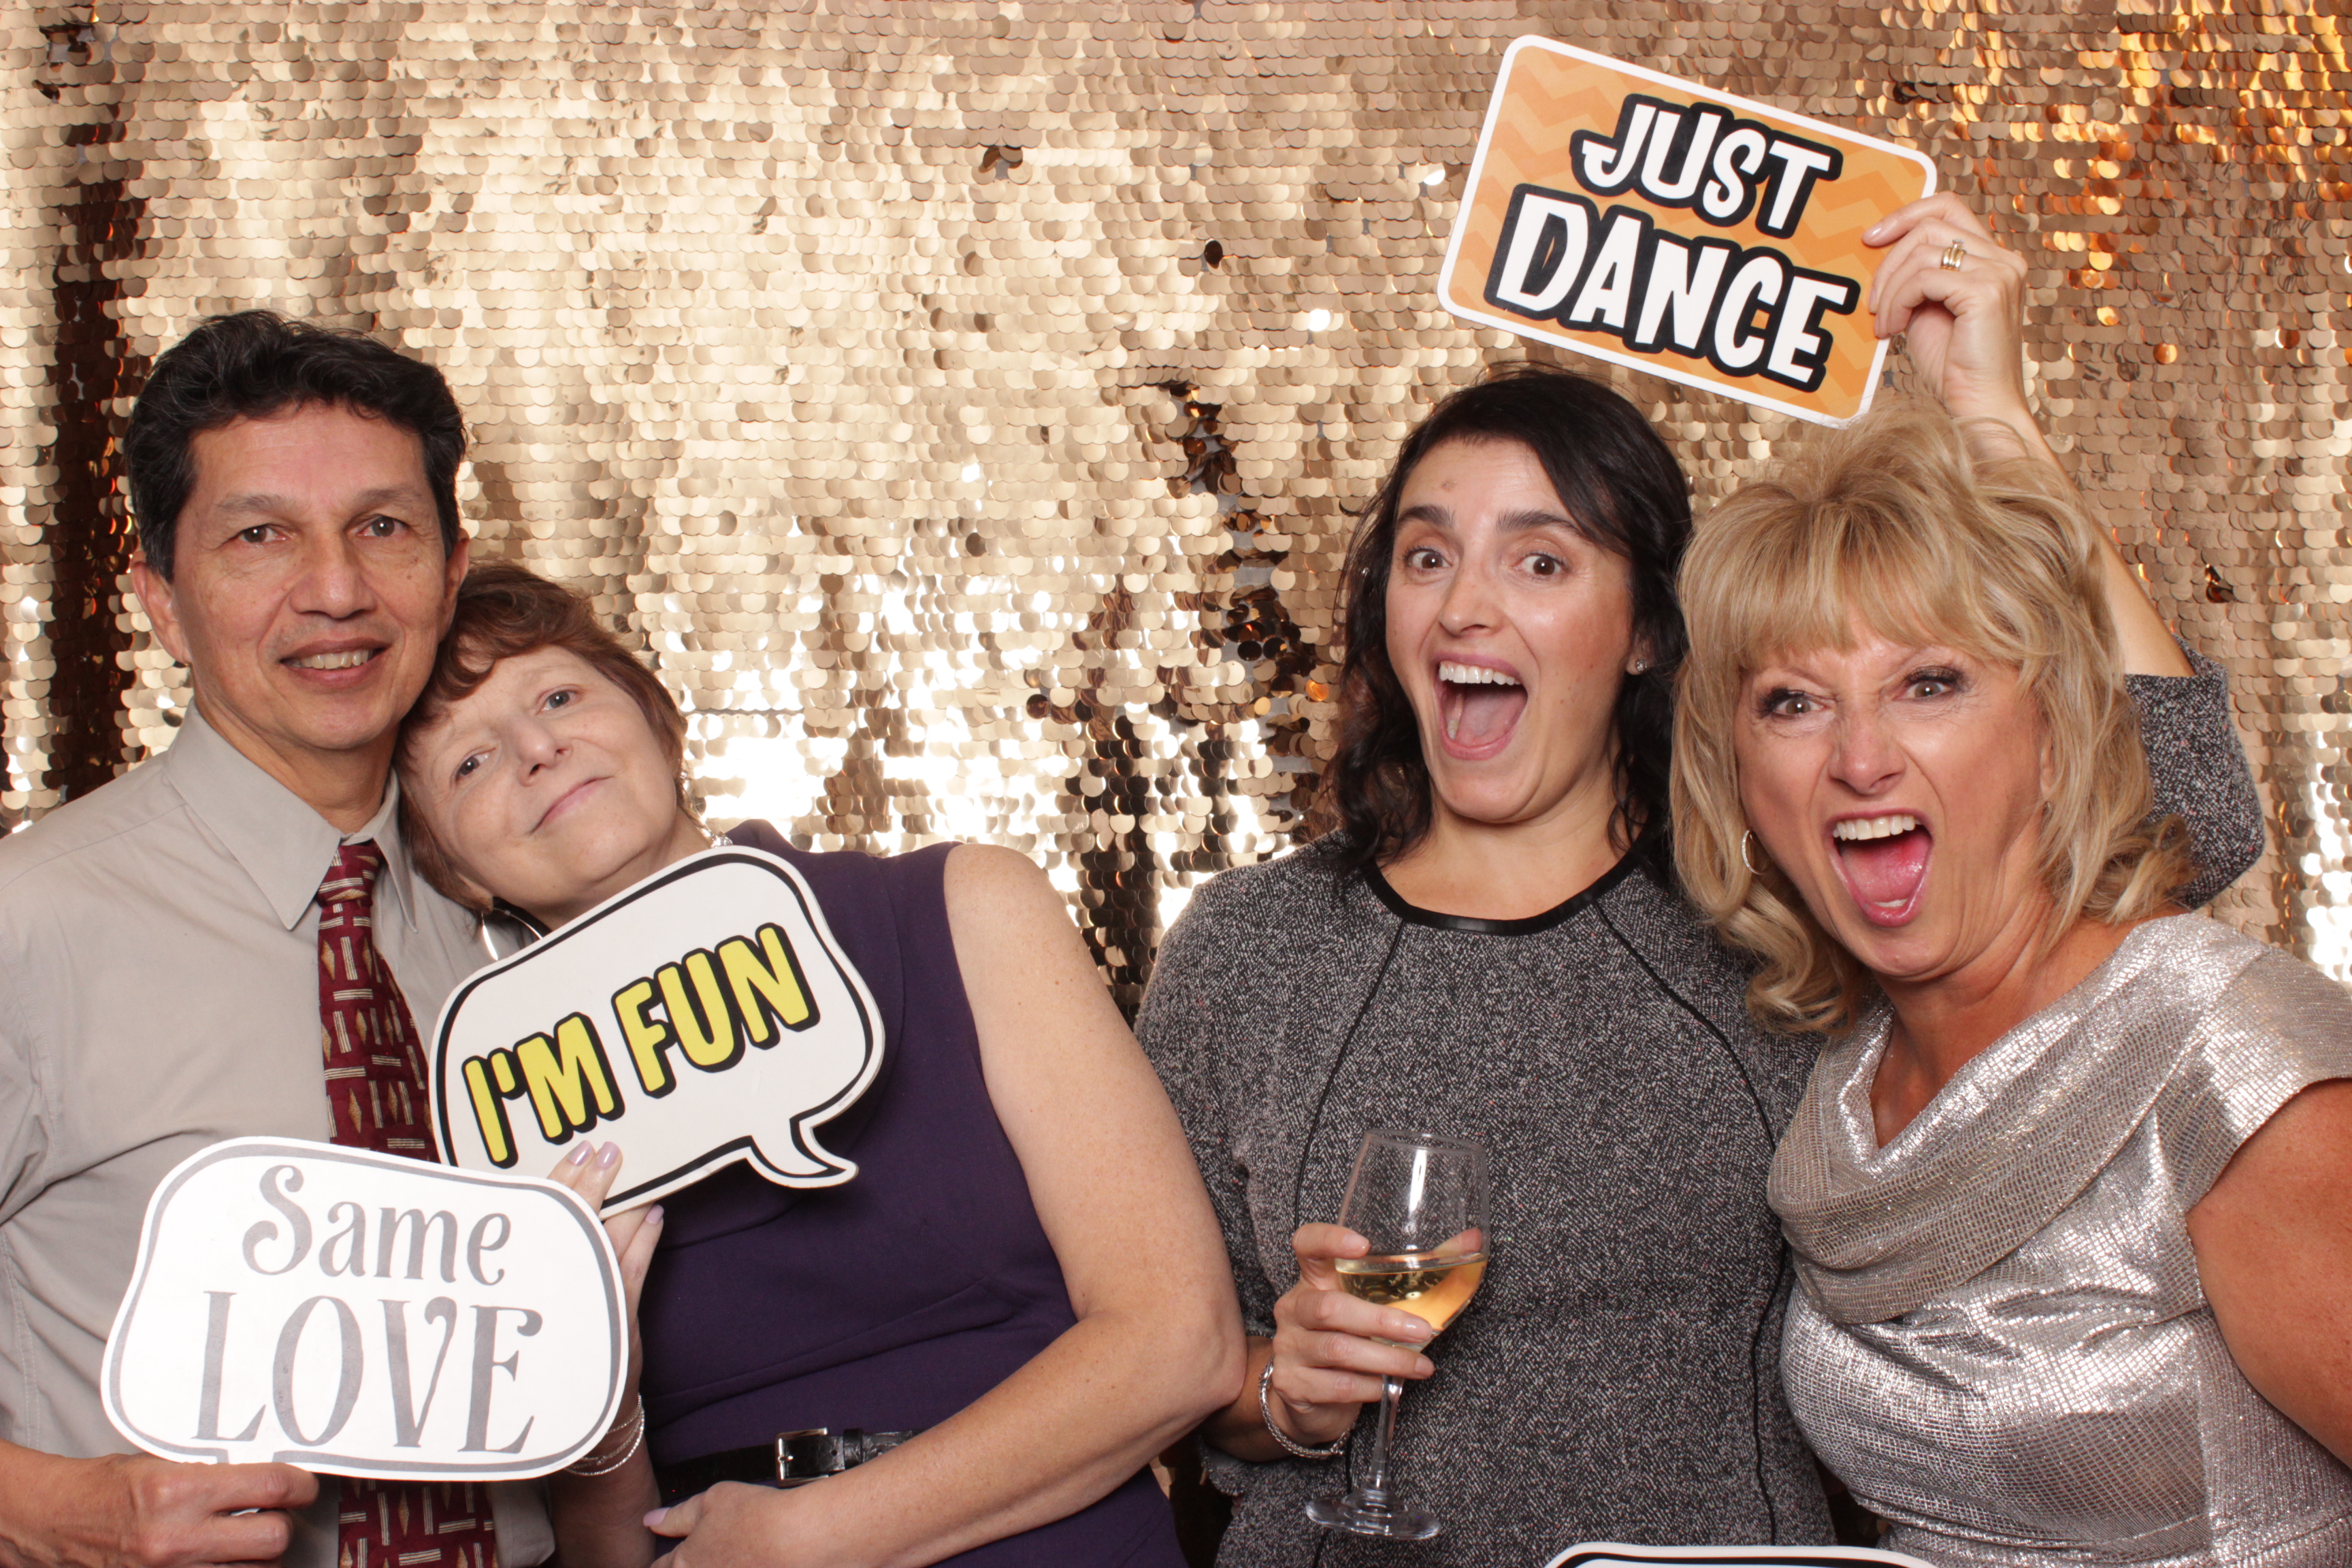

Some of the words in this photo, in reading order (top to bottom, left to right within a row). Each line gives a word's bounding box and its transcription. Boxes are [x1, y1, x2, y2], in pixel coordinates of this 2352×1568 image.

[1570, 94, 1842, 238] JUST
[1484, 184, 1860, 392] DANCE
[461, 1013, 624, 1169] I'M
[612, 924, 820, 1097] FUN
[242, 1164, 511, 1286] Same
[191, 1291, 542, 1454] LOVE
